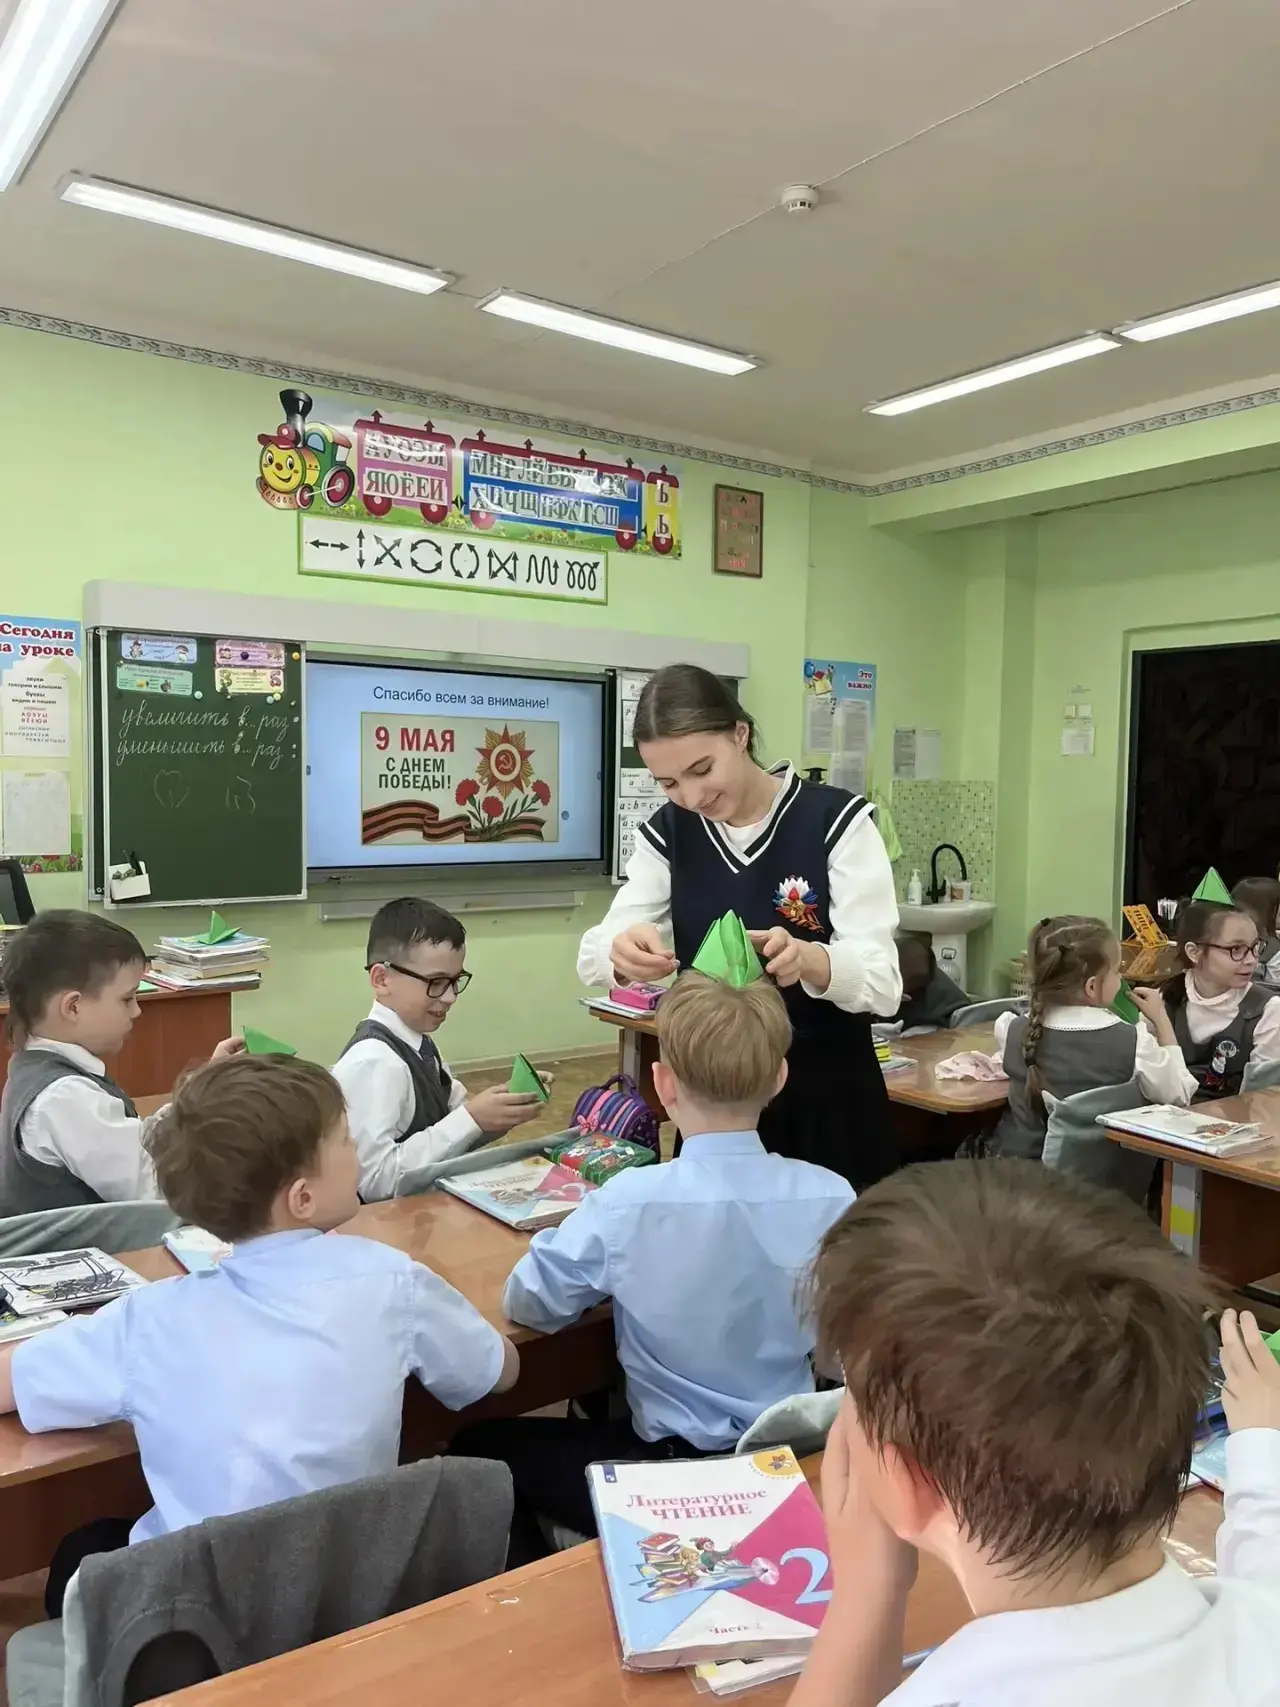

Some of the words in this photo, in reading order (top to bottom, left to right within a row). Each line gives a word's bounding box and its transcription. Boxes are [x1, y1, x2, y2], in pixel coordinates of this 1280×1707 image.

[0, 623, 74, 640] Сегодня
[0, 643, 12, 652] а
[21, 645, 74, 656] уроке
[373, 686, 431, 702] Спасибо
[436, 693, 467, 704] всем
[470, 695, 484, 705] за
[488, 696, 550, 709] внимание!
[375, 726, 390, 751] 9
[400, 727, 455, 753] МАЯ
[386, 757, 396, 772] С
[400, 758, 445, 775] ДНЕМ
[379, 774, 451, 791] ПОБЕДЫ!
[627, 1489, 768, 1507] Литературное
[651, 1503, 752, 1520] ЧТЕНИЕ
[780, 1547, 833, 1605] 2
